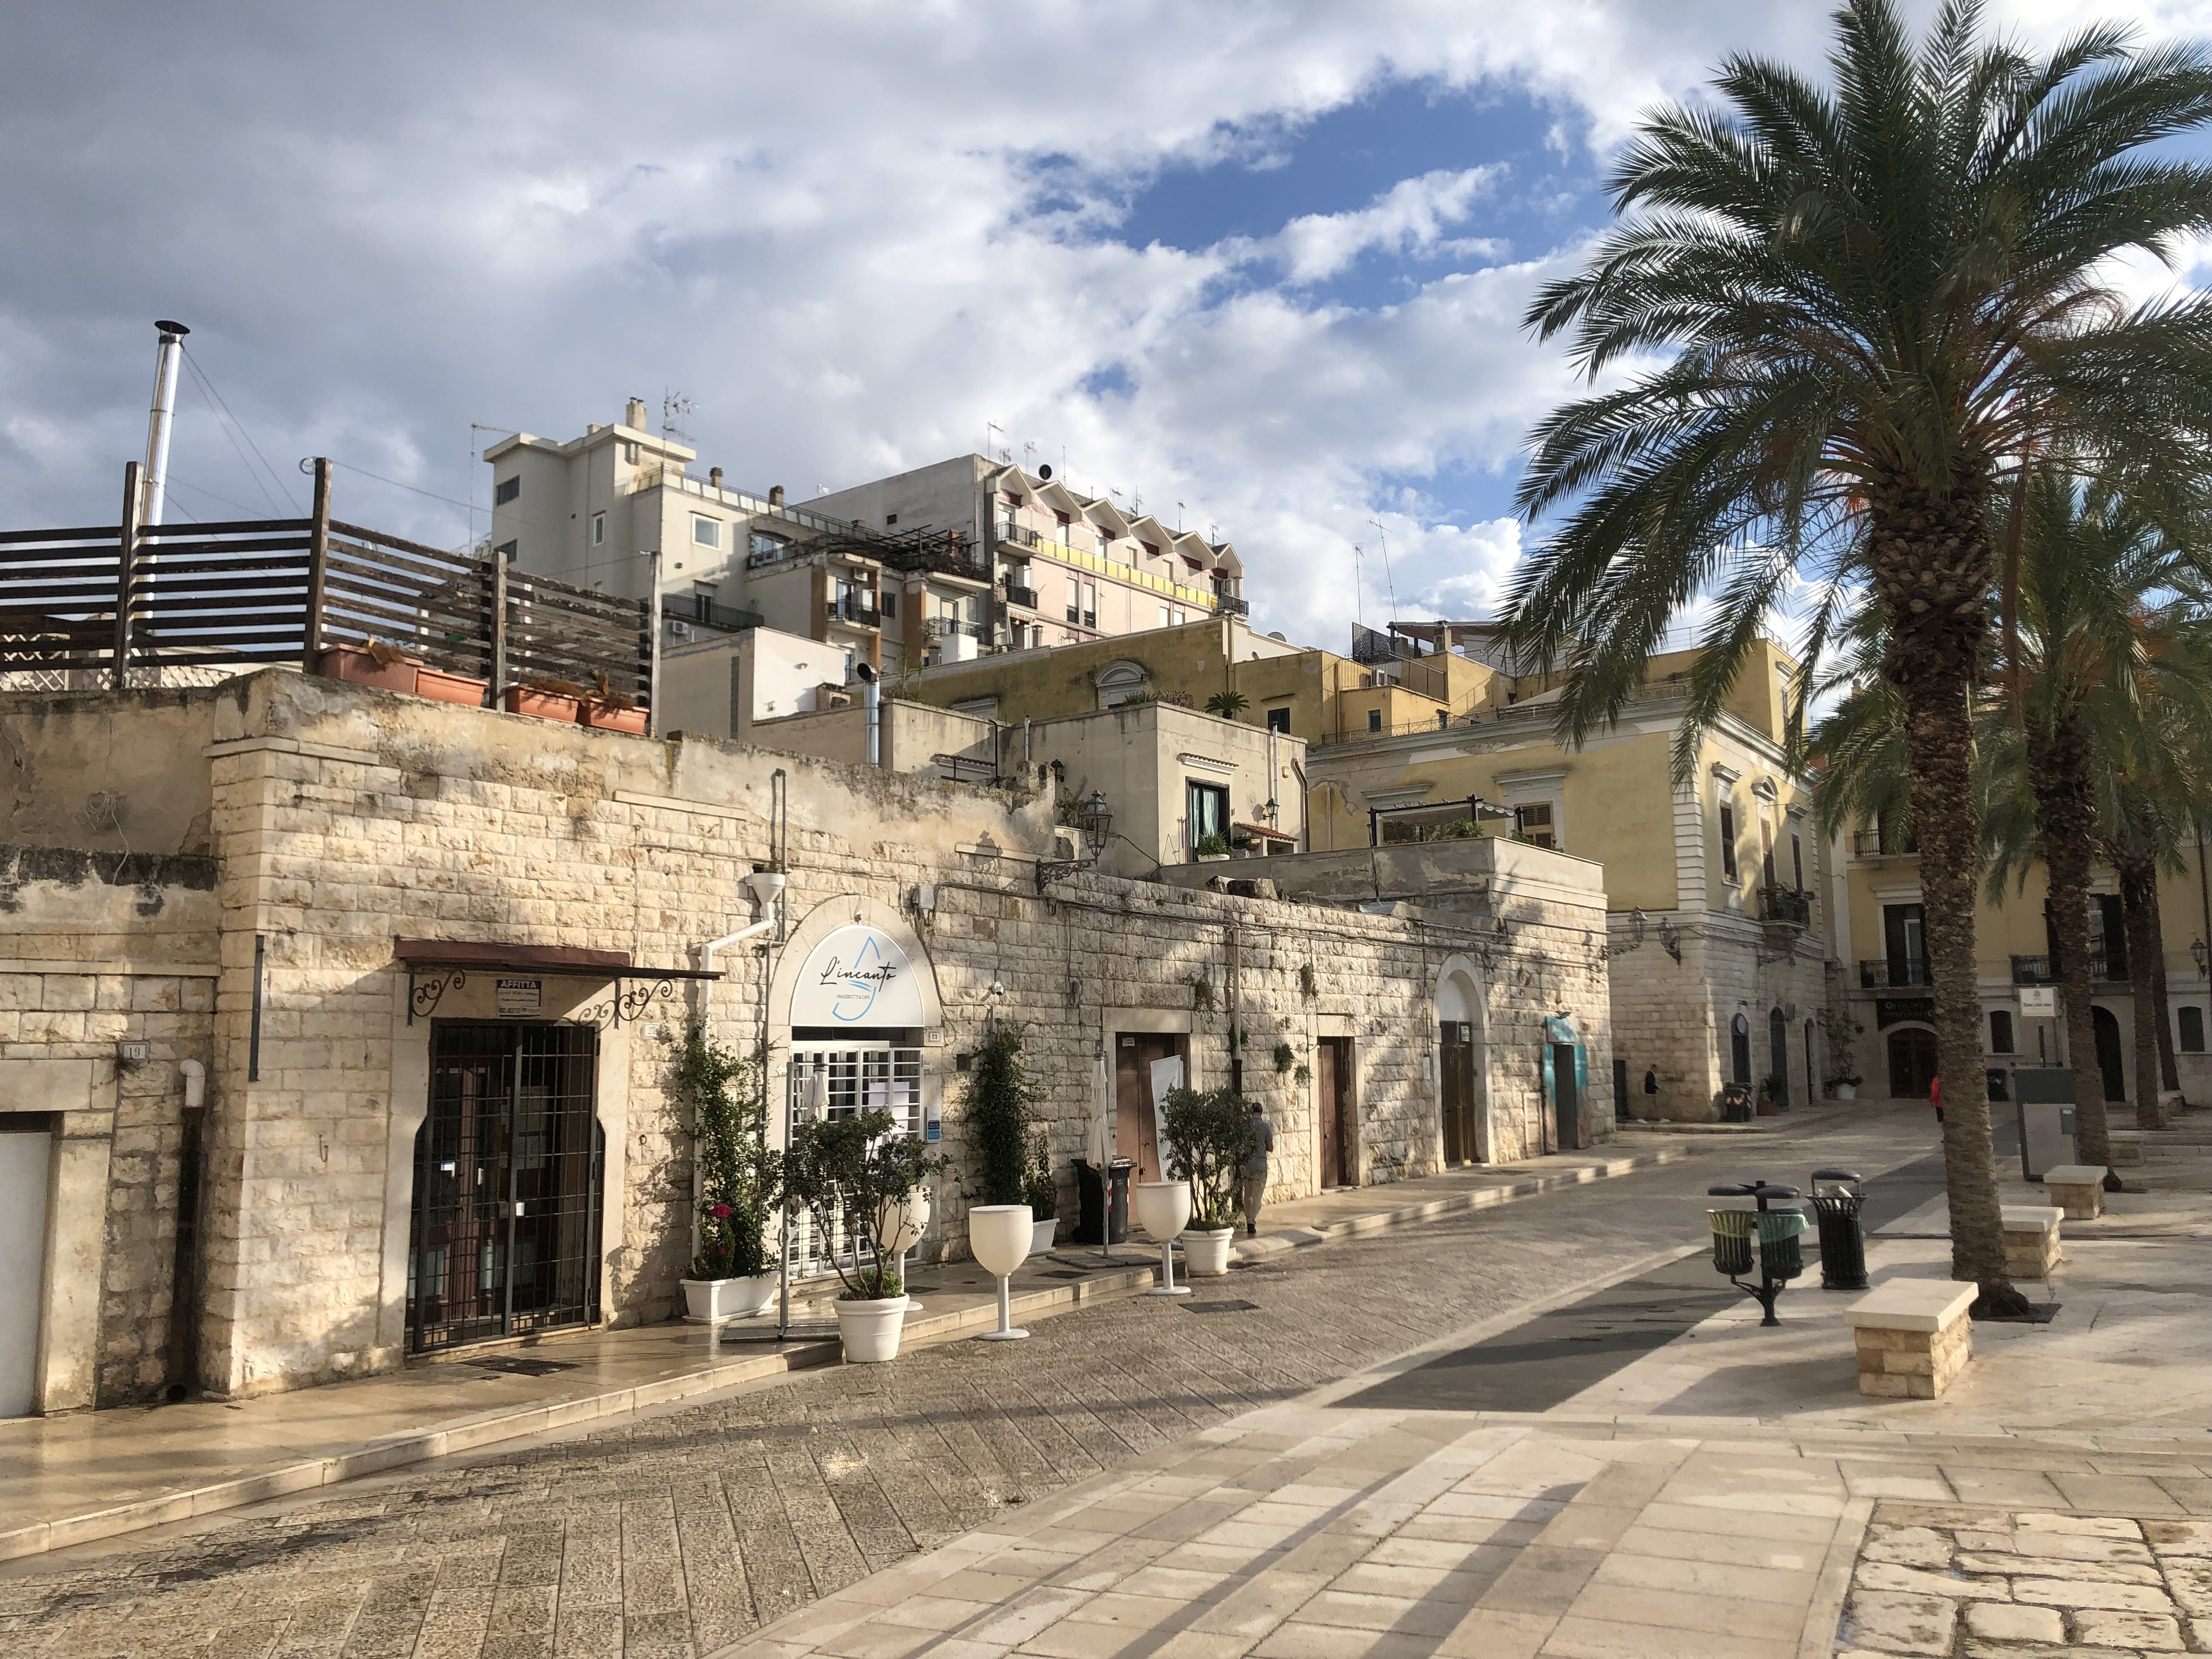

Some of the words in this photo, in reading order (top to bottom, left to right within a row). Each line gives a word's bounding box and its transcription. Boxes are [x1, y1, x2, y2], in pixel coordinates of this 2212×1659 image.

[820, 956, 896, 992] L'incanto
[500, 980, 536, 988] AFFITTA
[129, 1047, 140, 1057] 19
